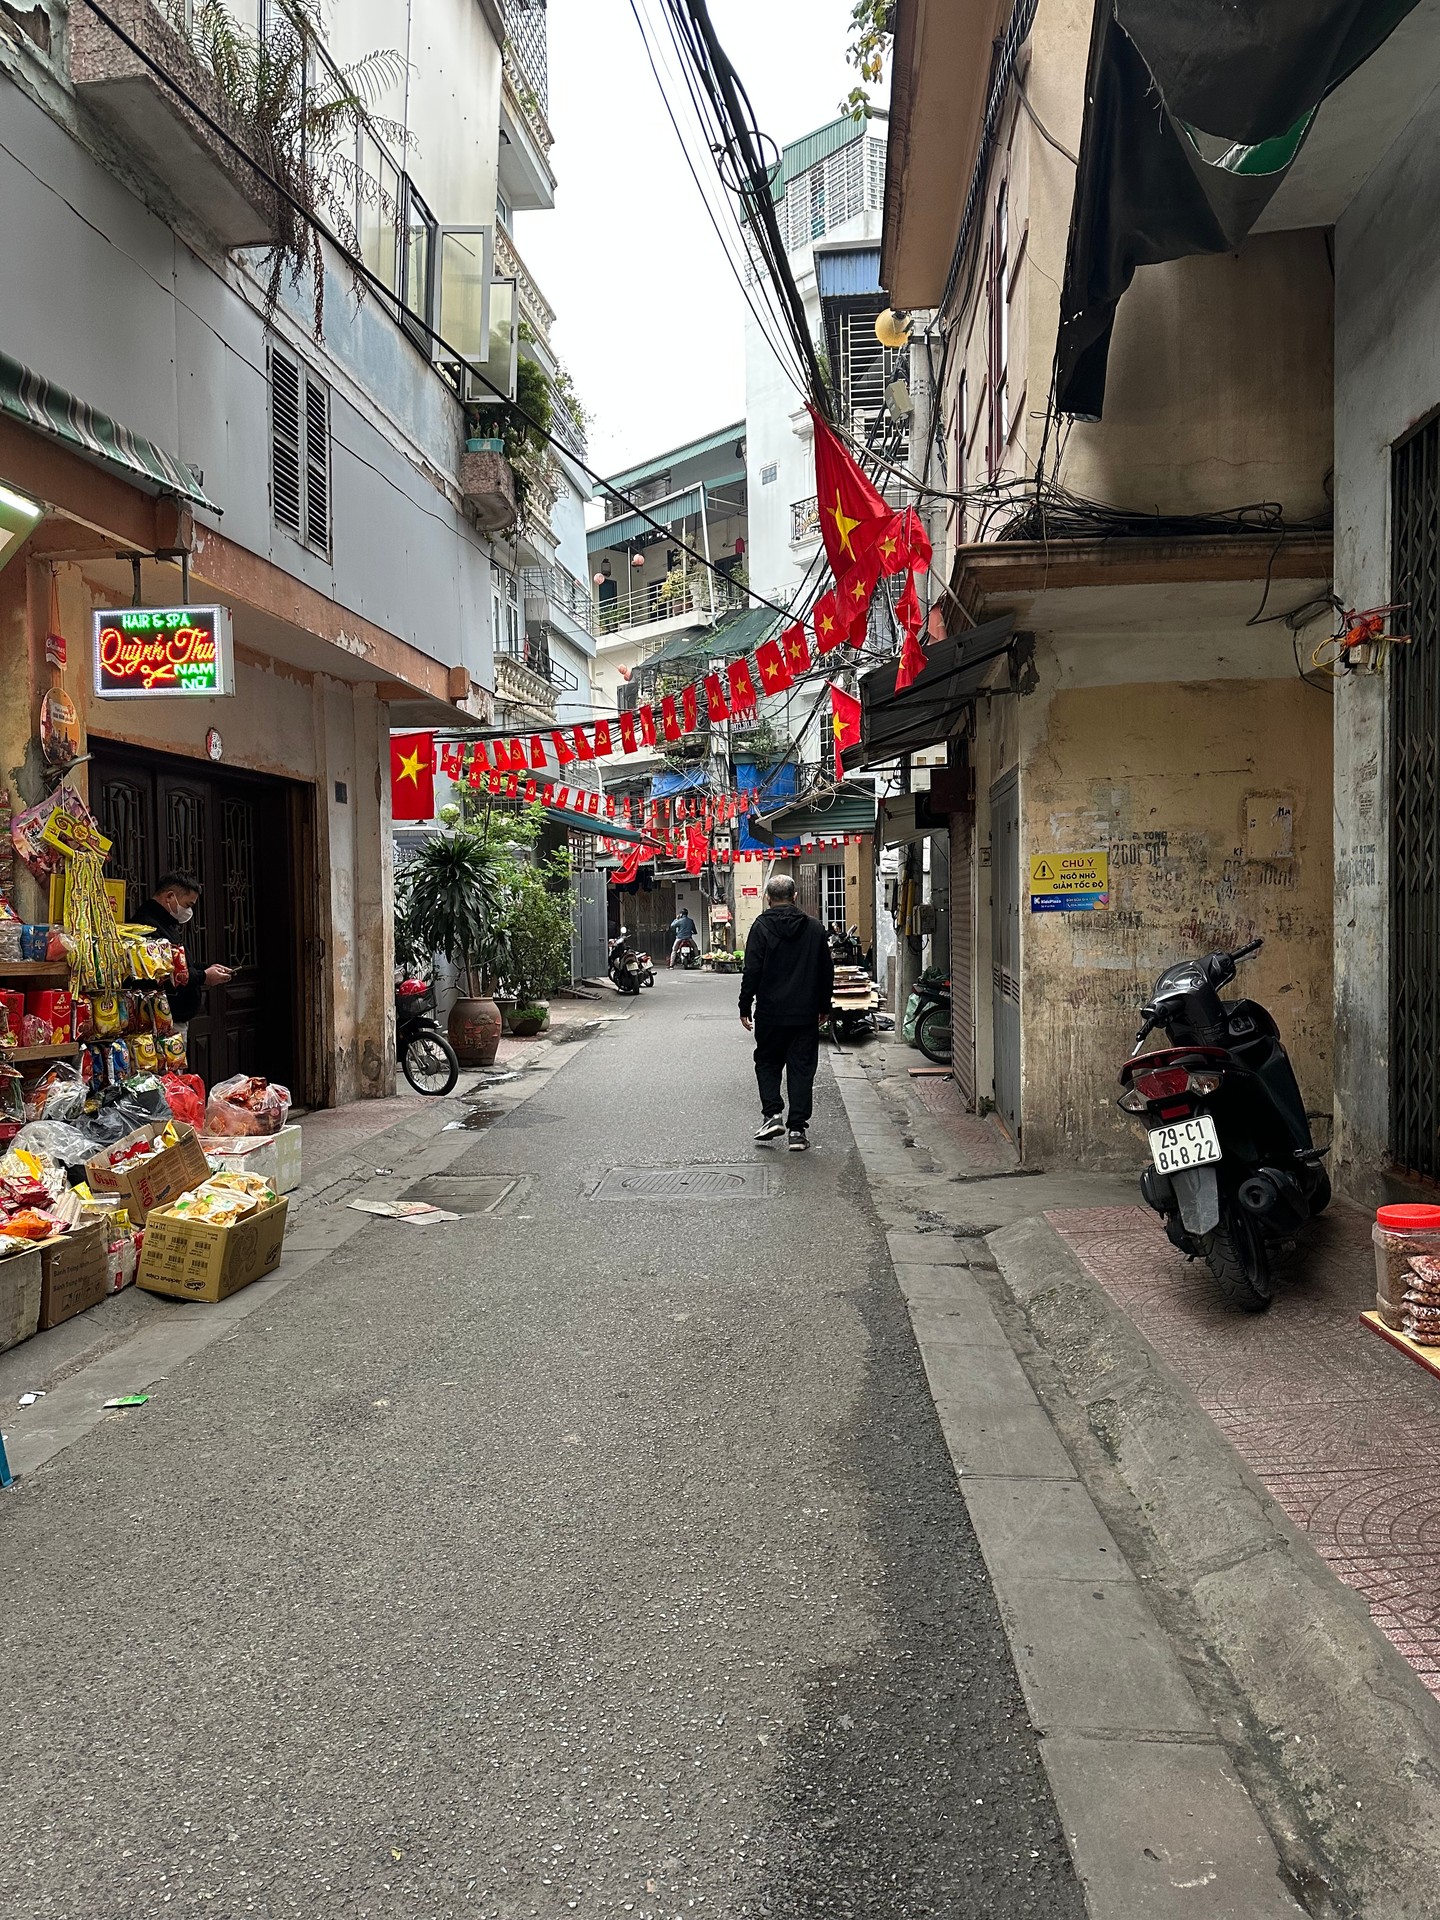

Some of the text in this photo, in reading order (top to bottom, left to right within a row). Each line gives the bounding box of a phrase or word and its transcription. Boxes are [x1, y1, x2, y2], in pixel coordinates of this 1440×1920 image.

[122, 613, 190, 629] HAIR & SPA
[174, 662, 214, 676] NAM
[1061, 857, 1095, 868] CHÚ Ý
[1053, 880, 1104, 890] GIẢM TỐC ĐỘ
[1158, 1121, 1205, 1149] 29-C1
[1158, 1140, 1217, 1170] 848.22
[93, 1172, 118, 1187] Oishi
[137, 1177, 153, 1208] Oishi
